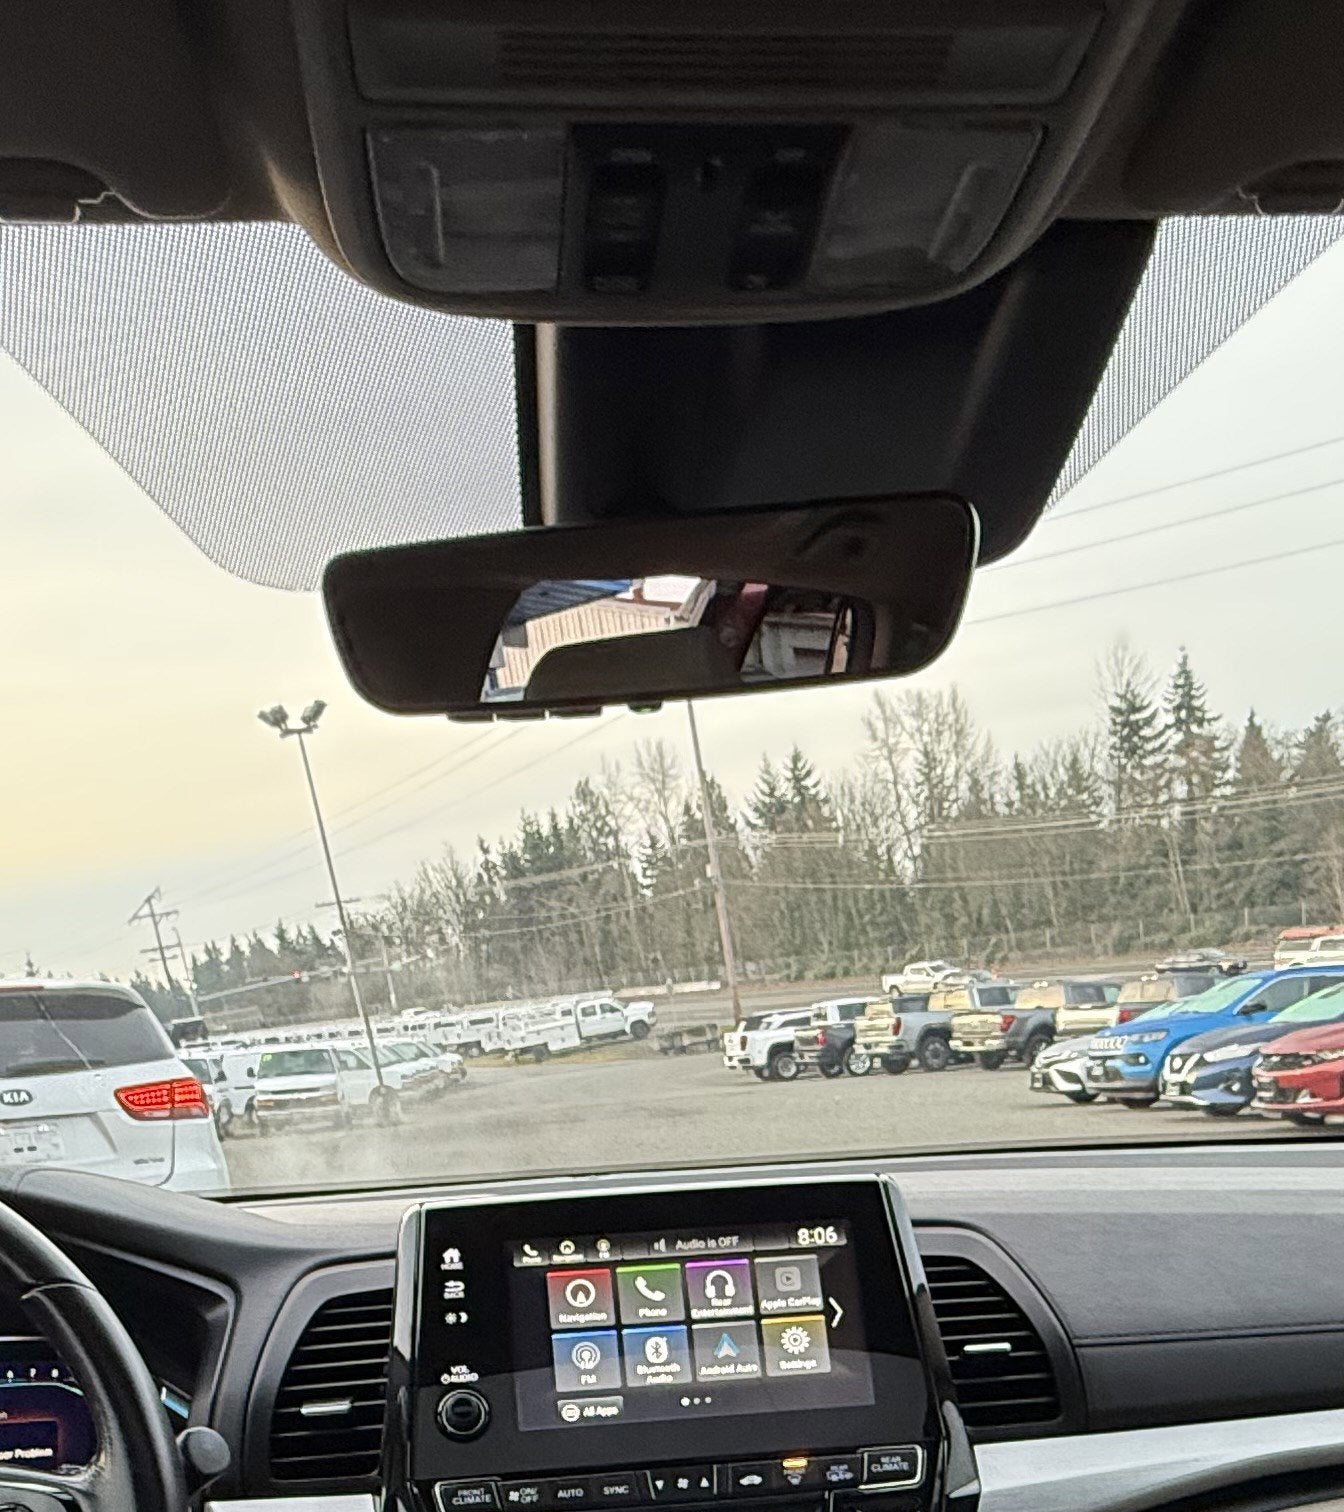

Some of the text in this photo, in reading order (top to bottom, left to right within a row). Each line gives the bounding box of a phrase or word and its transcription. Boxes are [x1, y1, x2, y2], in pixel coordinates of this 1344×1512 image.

[3, 1091, 30, 1103] KIA
[718, 1235, 739, 1247] OFF
[797, 1226, 838, 1245] 8:06
[557, 1488, 584, 1499] AUTO
[603, 1485, 630, 1496] SYNC
[452, 1494, 492, 1505] CLIMATE
